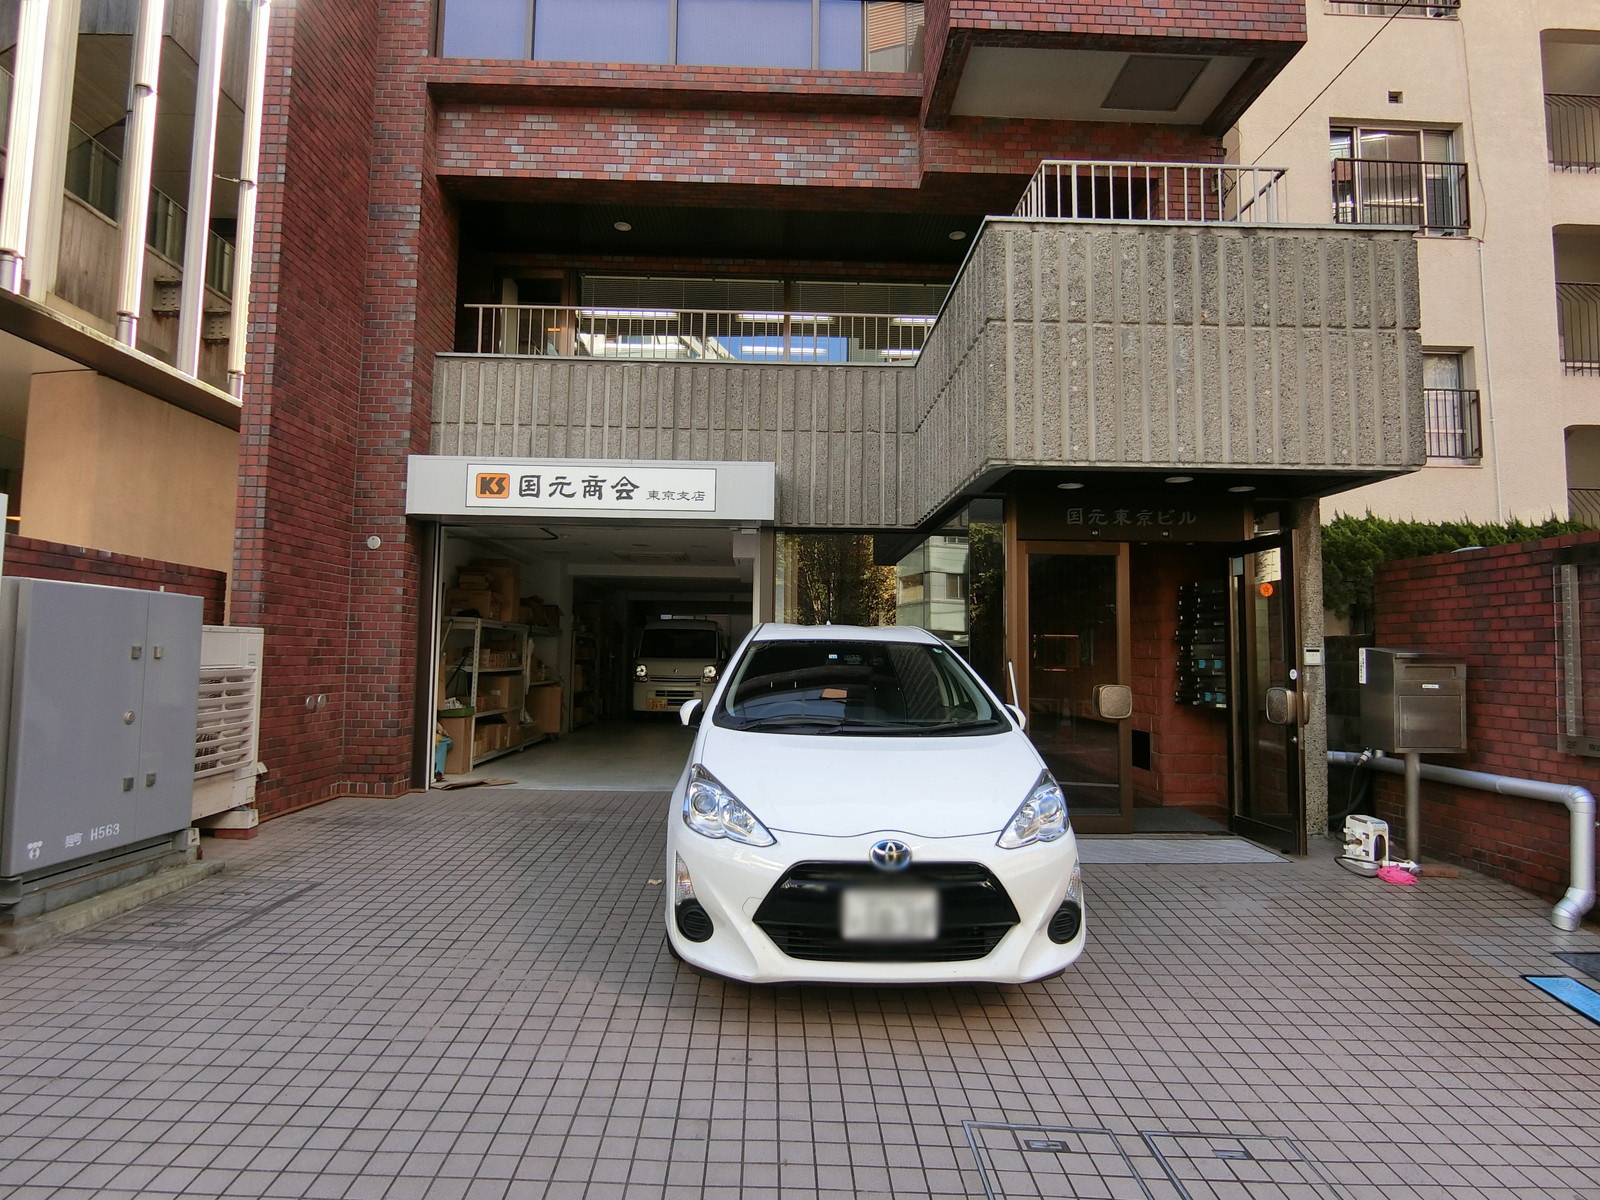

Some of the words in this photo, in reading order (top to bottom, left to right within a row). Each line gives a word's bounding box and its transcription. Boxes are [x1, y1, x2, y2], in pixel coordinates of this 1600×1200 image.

[480, 476, 507, 495] KS
[518, 474, 640, 501] 国元商会
[646, 490, 706, 502] 東京支店
[1066, 507, 1197, 527] 国元東京ビル
[90, 823, 120, 841] H563
